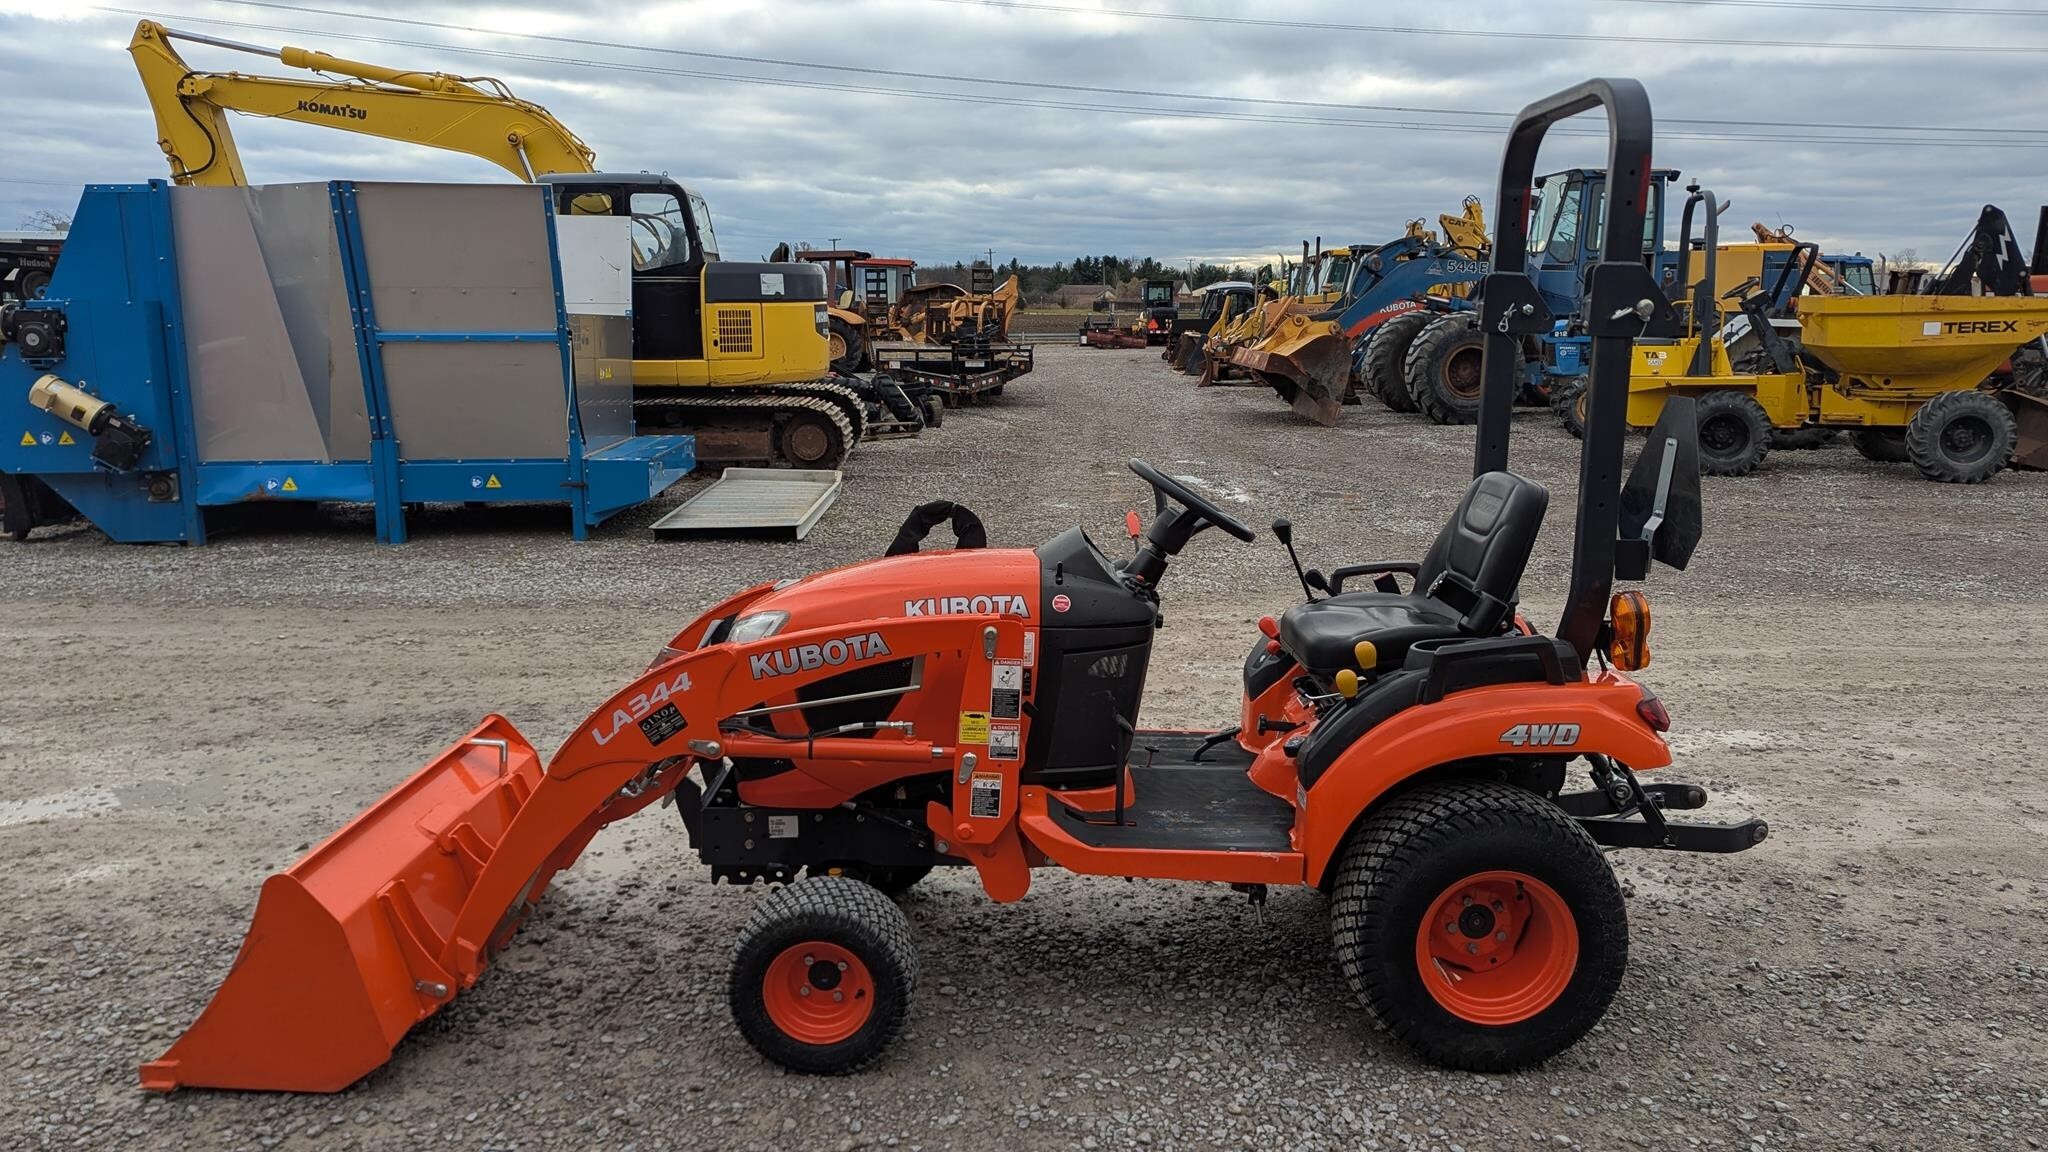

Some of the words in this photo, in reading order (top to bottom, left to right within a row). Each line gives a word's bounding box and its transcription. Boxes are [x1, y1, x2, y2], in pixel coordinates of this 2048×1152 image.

[298, 100, 367, 120] KOMATSU
[1448, 218, 1467, 227] CAT
[1447, 260, 1489, 274] 544E
[1944, 320, 2018, 334] TEREX
[904, 594, 1031, 618] KUBOTA
[749, 631, 892, 680] KUBOTA
[591, 671, 692, 746] LA344
[642, 706, 676, 731] GINOP
[1499, 723, 1581, 746] 4WD
